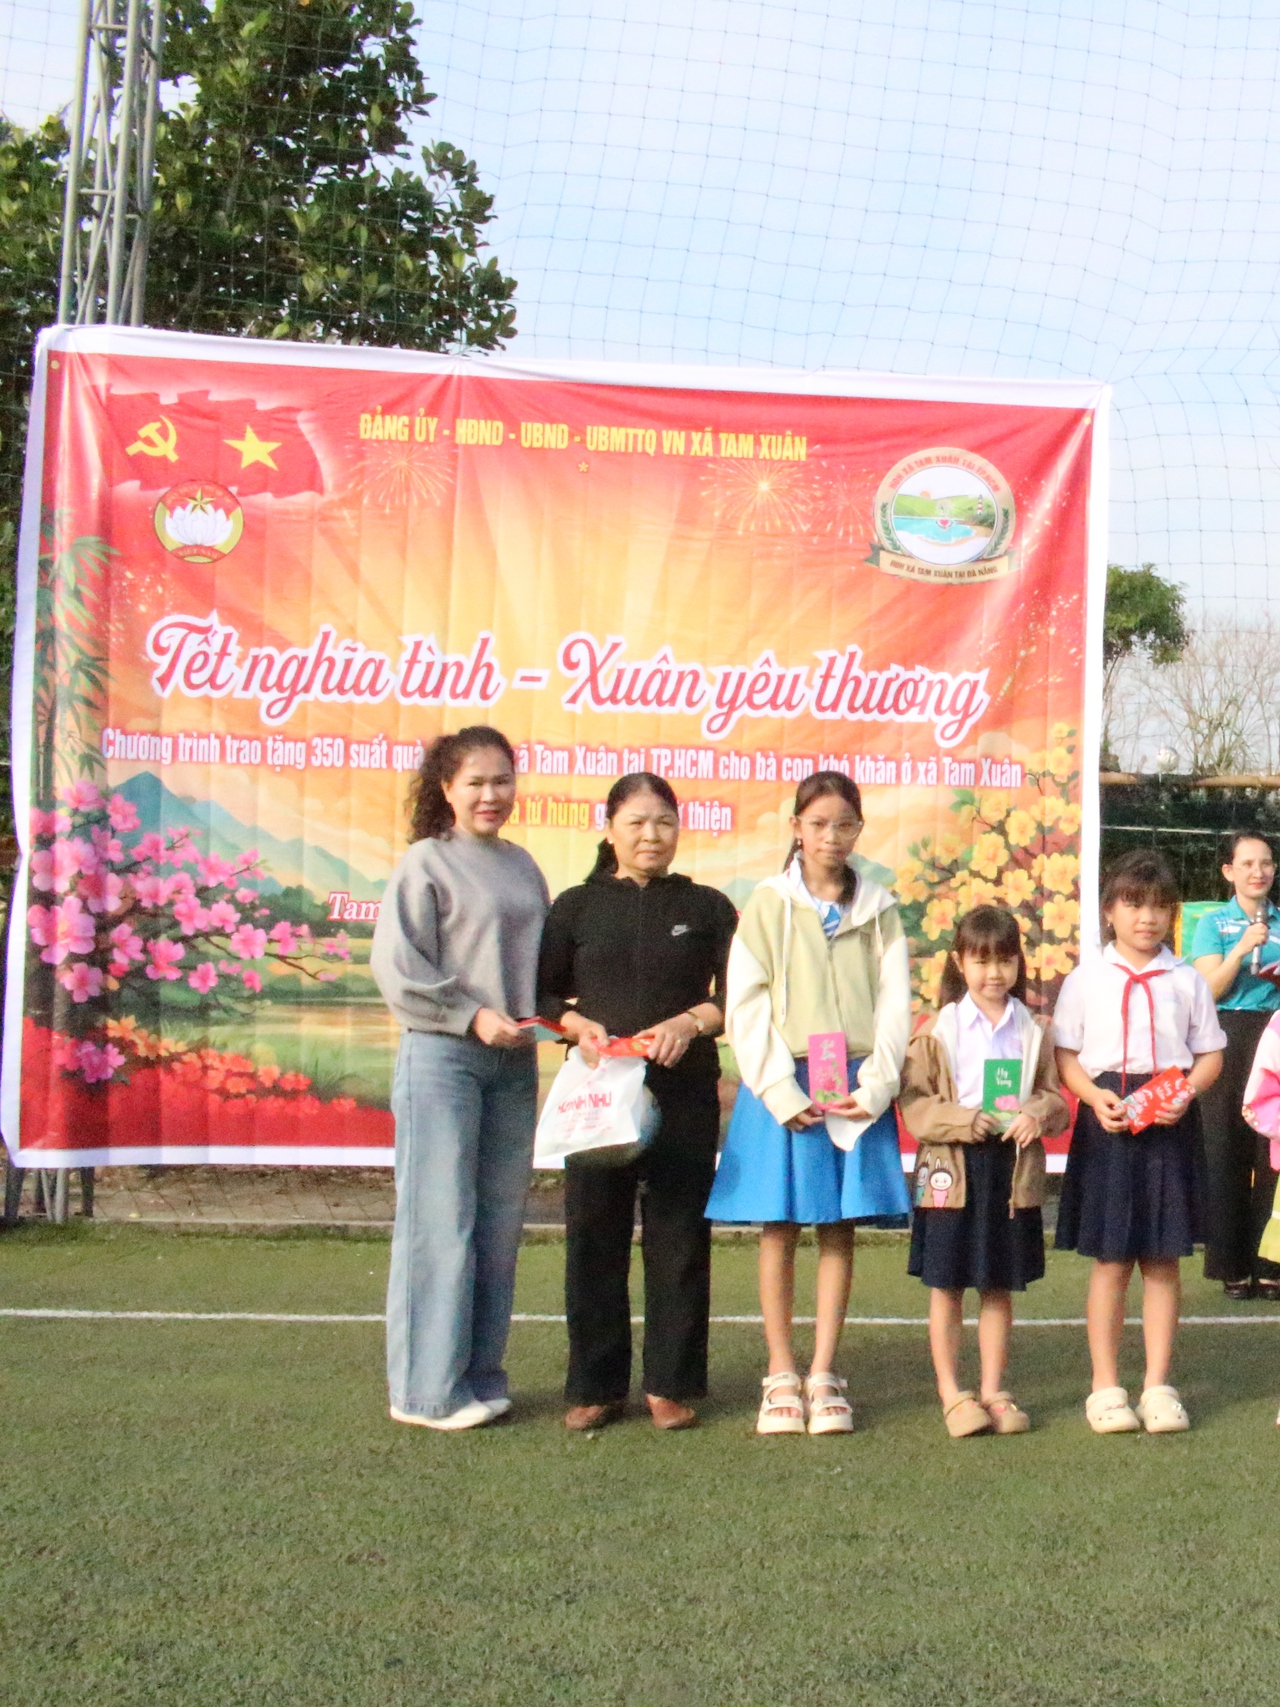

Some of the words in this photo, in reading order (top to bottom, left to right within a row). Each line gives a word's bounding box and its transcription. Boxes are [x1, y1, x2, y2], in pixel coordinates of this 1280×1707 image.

[359, 405, 410, 442] ĐẢNG
[414, 408, 439, 443] ỦY
[455, 418, 504, 446] HĐND
[520, 421, 569, 450] UBND
[586, 425, 658, 456] UBMTTQ
[661, 429, 686, 456] VN
[689, 427, 714, 457] XÃ
[718, 432, 755, 459] TAM
[758, 430, 807, 462] XUÂN
[150, 618, 237, 696] Tết
[241, 628, 391, 722] nghĩa
[398, 633, 503, 704] tình
[559, 635, 707, 710] Xuân
[704, 653, 806, 737] yêu
[814, 648, 986, 745] thương
[101, 726, 173, 765] Chương
[178, 733, 220, 763] trình
[225, 734, 262, 765] trao
[266, 734, 307, 772] tặng
[311, 737, 345, 768] 350
[350, 733, 388, 769] suất
[392, 739, 425, 773] quà
[534, 744, 569, 775] Tam
[573, 745, 618, 777] Xuân
[651, 746, 714, 780] TP.HCM
[718, 748, 751, 780] cho
[756, 750, 777, 781] bà
[781, 760, 813, 782] con
[854, 753, 897, 786] khăn
[901, 752, 912, 786] ở
[917, 754, 938, 786] xã
[942, 757, 976, 786] Tam
[979, 757, 1022, 788] Xuân
[525, 796, 543, 824] tứ
[687, 800, 732, 837] thiện
[328, 893, 382, 920] Tam
